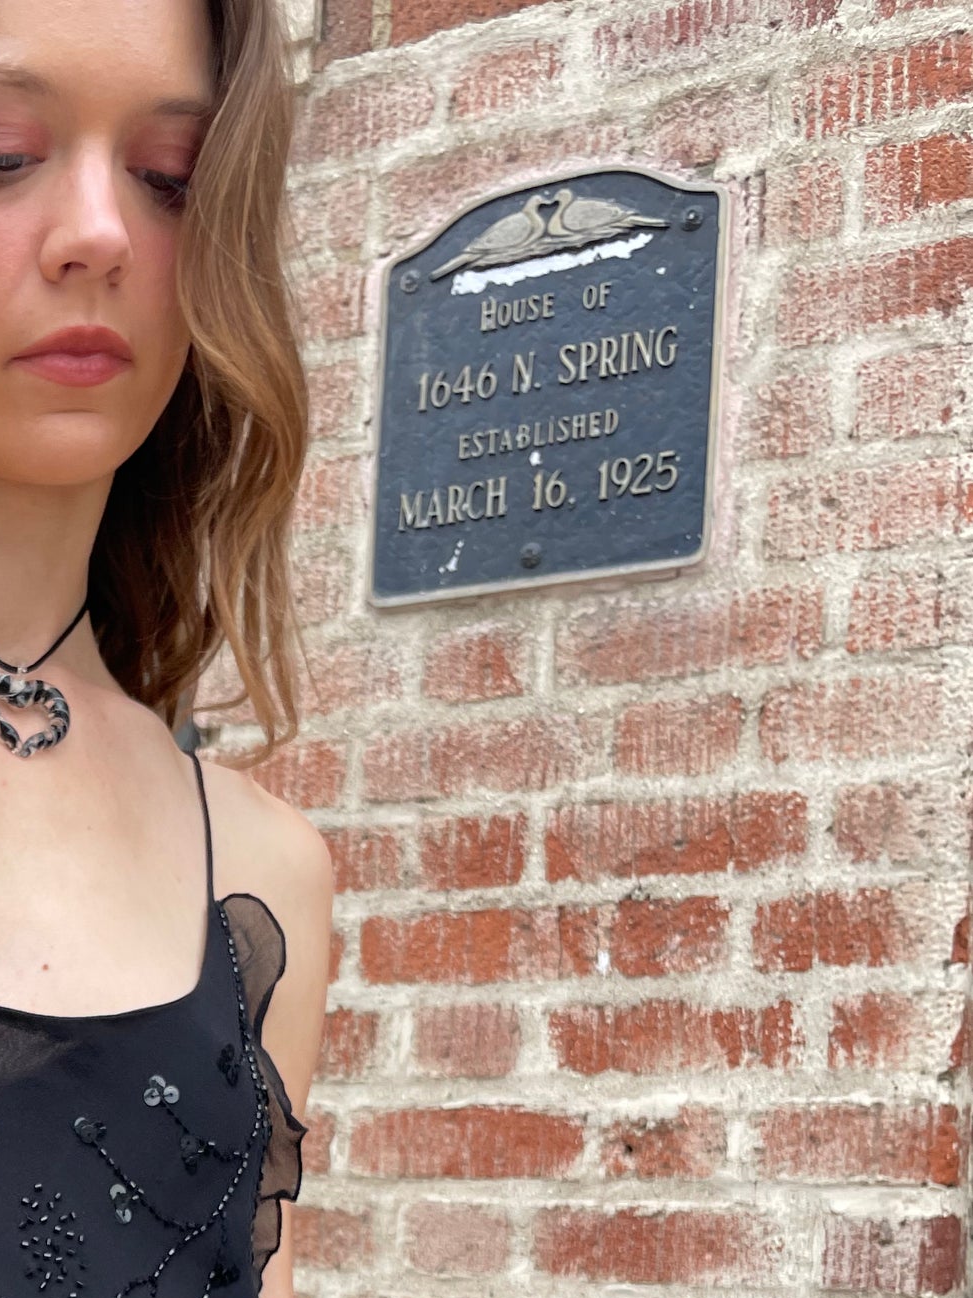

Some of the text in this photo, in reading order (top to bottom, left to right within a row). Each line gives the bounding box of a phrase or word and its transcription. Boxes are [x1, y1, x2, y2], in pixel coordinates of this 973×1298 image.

[480, 281, 613, 332] HOUSE OF
[417, 325, 679, 413] 1646 N. SPRING
[458, 408, 620, 461] ESTABLISHED
[397, 476, 508, 532] MARCH
[597, 450, 679, 501] 1925
